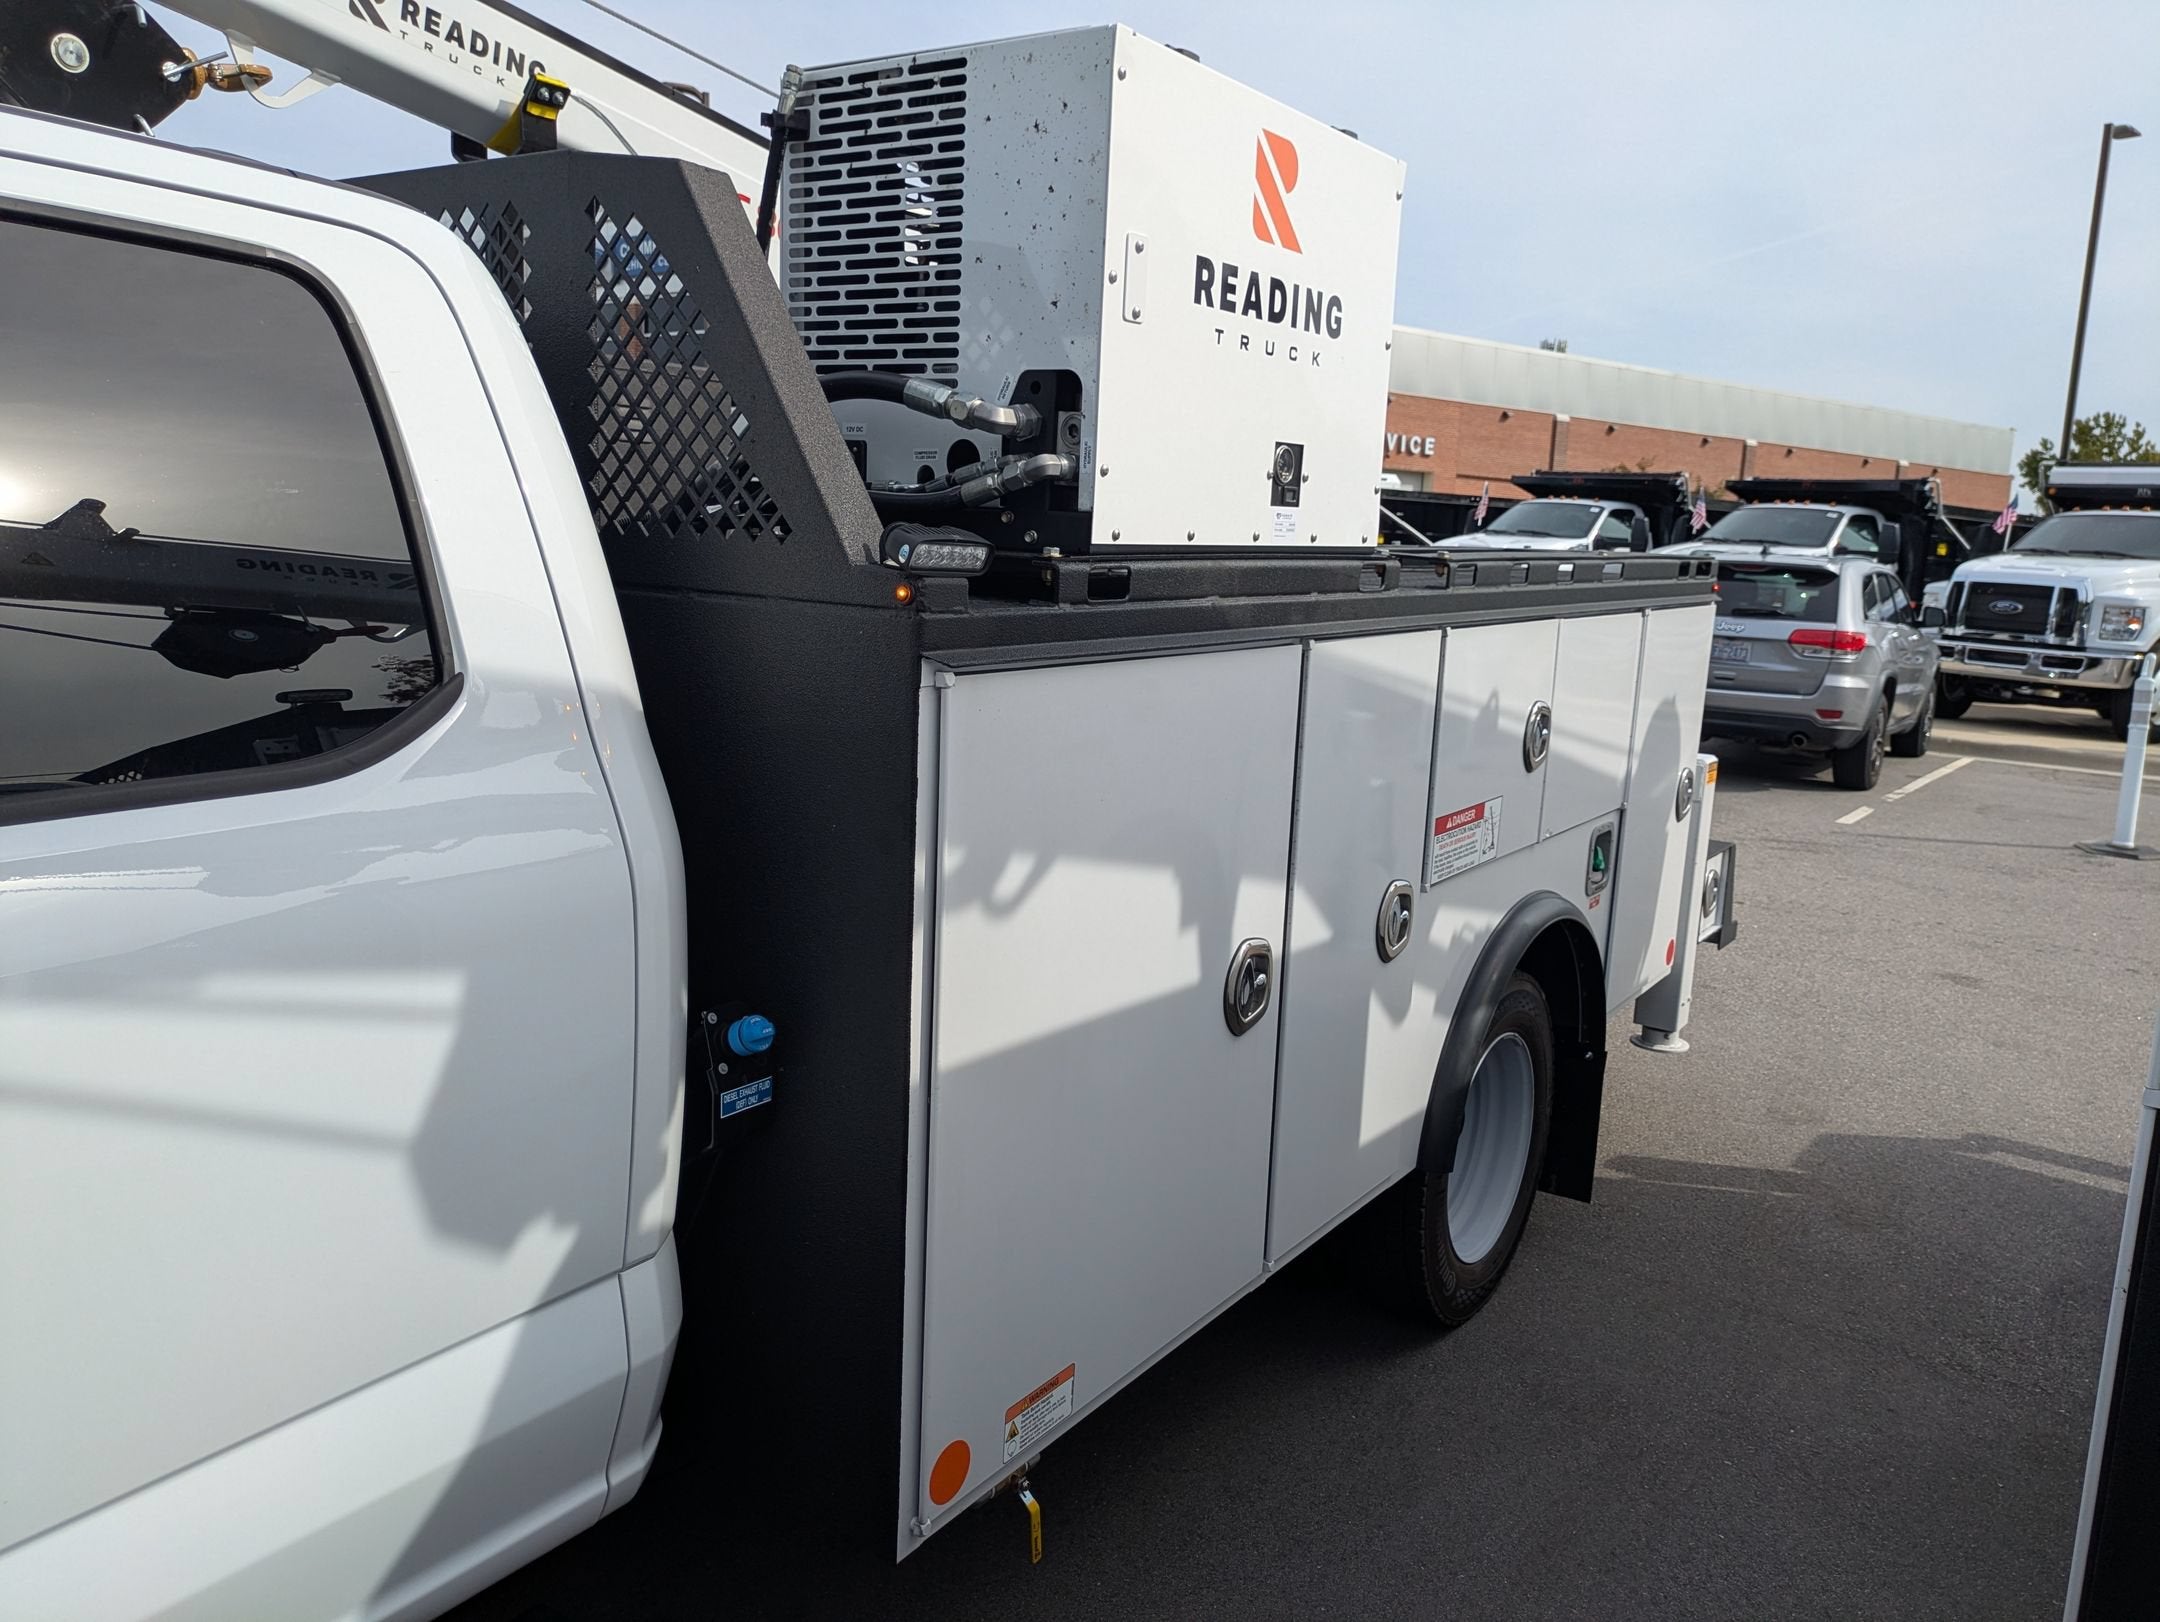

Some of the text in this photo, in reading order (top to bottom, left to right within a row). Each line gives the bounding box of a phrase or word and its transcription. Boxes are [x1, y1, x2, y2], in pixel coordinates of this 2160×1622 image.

[400, 30, 505, 86] TRUCK
[1194, 255, 1343, 339] READING
[1215, 328, 1321, 367] TRUCK
[1716, 621, 1745, 633] Jeep
[1453, 809, 1476, 826] DANGER
[723, 1080, 770, 1104] DIESEL EXHAUST FLUID
[748, 1095, 760, 1107] ONLY
[1028, 1376, 1060, 1404] WARNING
